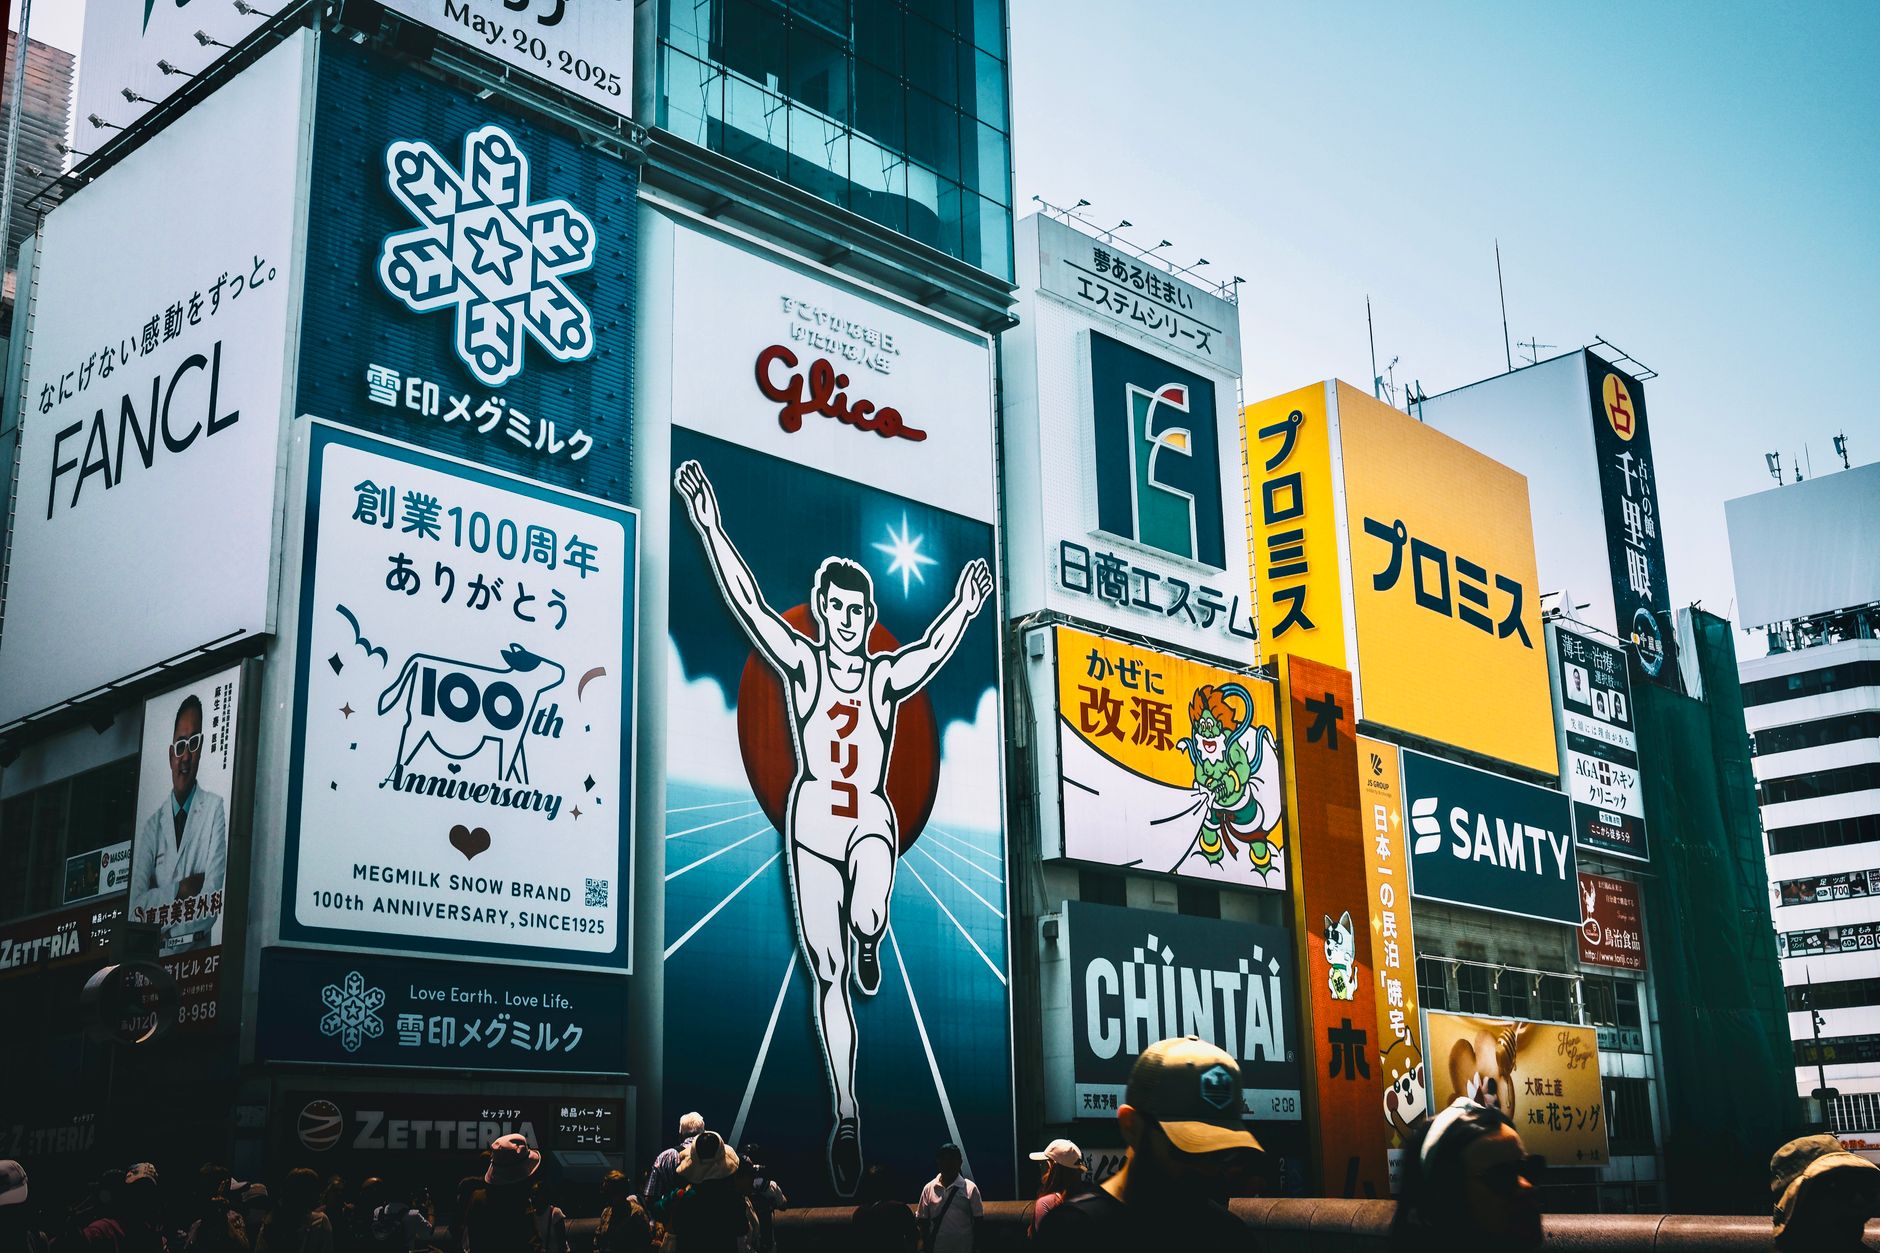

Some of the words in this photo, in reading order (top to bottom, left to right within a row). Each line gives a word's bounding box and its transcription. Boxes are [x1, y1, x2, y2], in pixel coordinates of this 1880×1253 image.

[443, 0, 508, 45] May.
[512, 29, 552, 68] 20,
[557, 50, 622, 97] 2025
[1093, 246, 1193, 310] 夢ある住まい
[38, 254, 277, 414] なにげない感動をずっと。
[790, 321, 892, 375] ゆたかな人生
[1077, 275, 1212, 356] エステムシリーズ
[366, 362, 594, 462] 雪印メグミルク
[755, 344, 928, 442] Glico
[1609, 376, 1631, 436] 占
[46, 339, 241, 521] FANCL
[351, 478, 600, 579] 創業100周年
[1258, 409, 1316, 639] プロミス
[1615, 450, 1653, 602] 千里眼
[385, 551, 570, 631] ありがとう
[1060, 539, 1259, 640] 日商エステム
[1363, 516, 1534, 650] プロミス
[1085, 648, 1165, 695] かぜに
[1077, 684, 1175, 751] 改源
[378, 763, 562, 821] Anniversary
[826, 698, 862, 819] グリコ
[1576, 758, 1599, 780] AGA
[1612, 770, 1635, 789] スキン
[1589, 785, 1627, 810] クリニック
[1450, 806, 1570, 881] SAMTY
[312, 890, 364, 911] 100th
[352, 863, 441, 889] MEGMILK
[449, 874, 504, 896] SNOW
[511, 882, 572, 903] BRAND
[410, 984, 446, 1001] Love
[451, 987, 498, 1005] Earth.
[505, 991, 539, 1008] Love
[543, 993, 574, 1010] Life.
[1085, 934, 1286, 1062] CHINTAI
[396, 1012, 584, 1053] 雪印メグミルク
[481, 1109, 521, 1119] ゼッテリア
[559, 1107, 612, 1119] 絶品バーガー
[1525, 1077, 1564, 1098] 大阪土産
[576, 1134, 612, 1145] コーヒー
